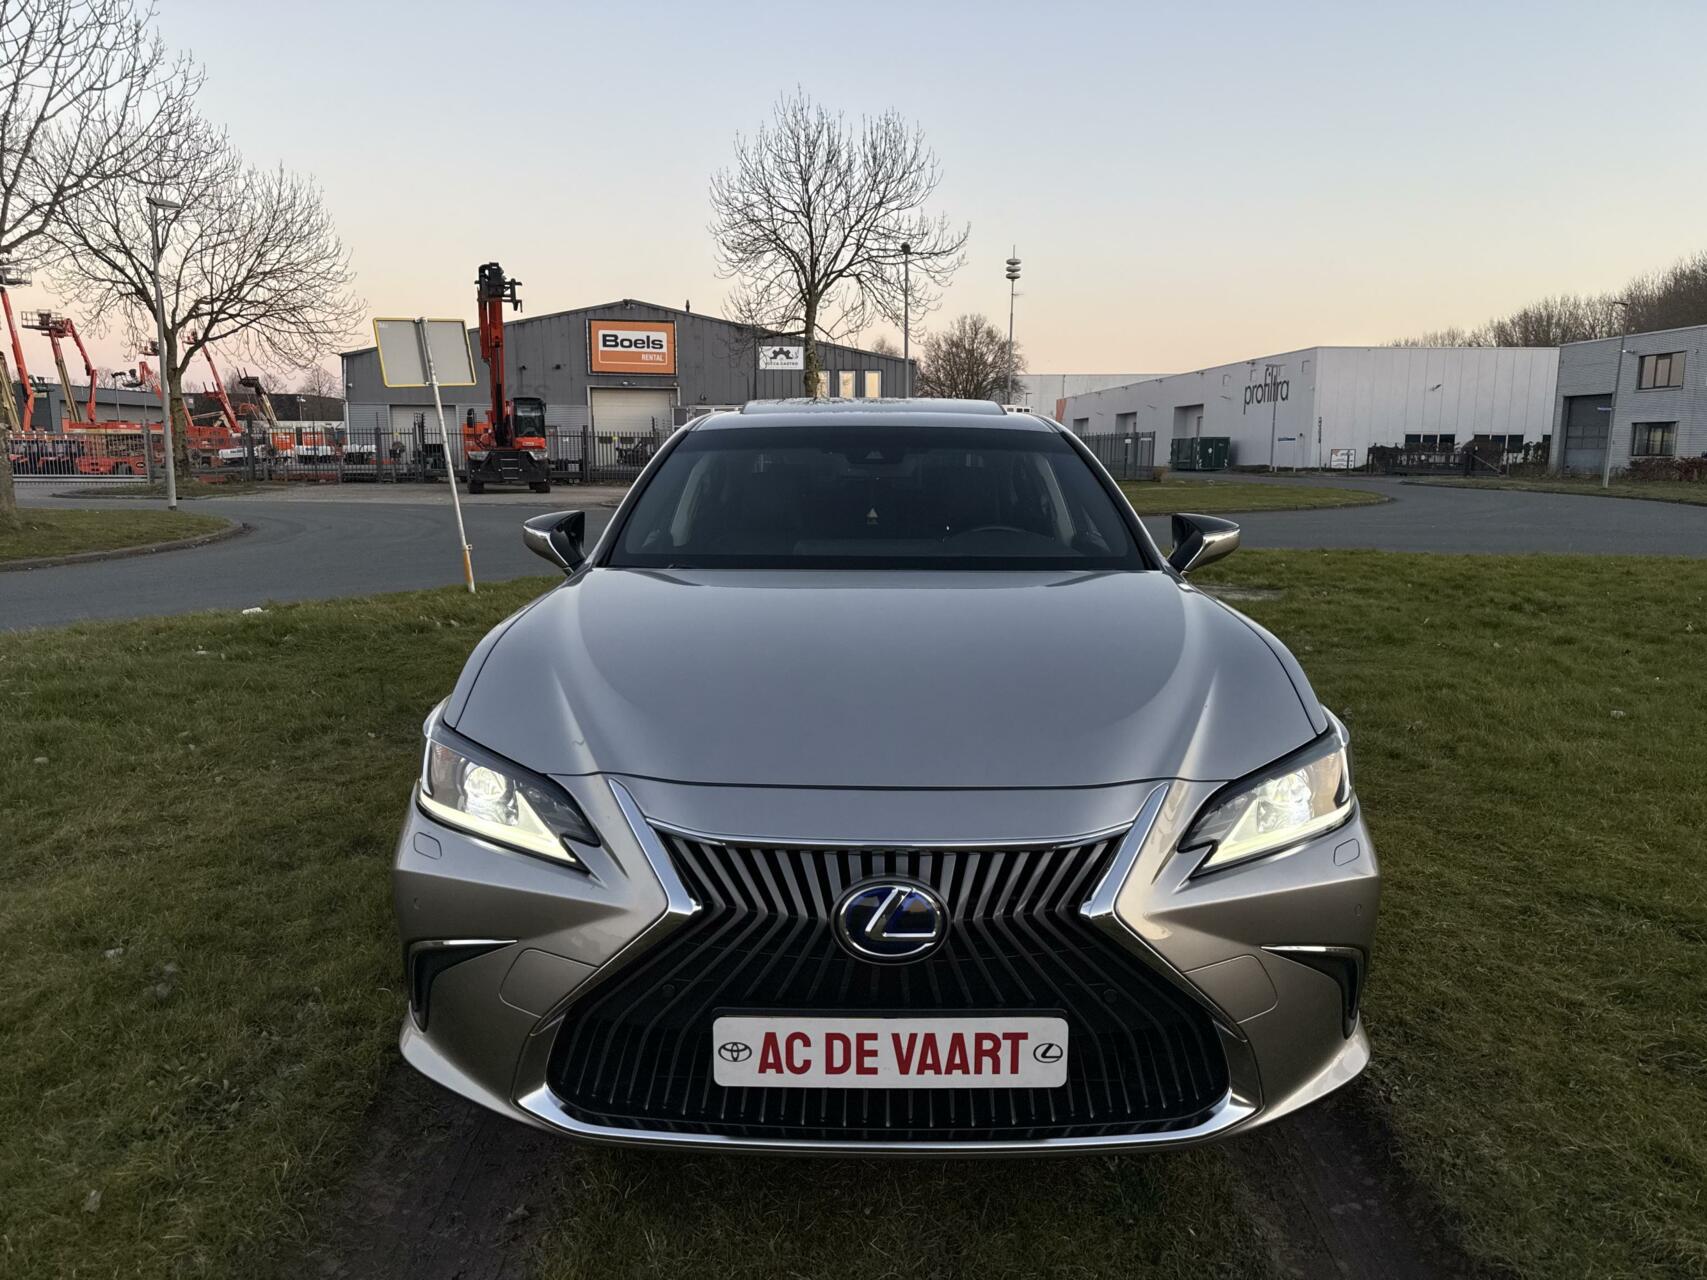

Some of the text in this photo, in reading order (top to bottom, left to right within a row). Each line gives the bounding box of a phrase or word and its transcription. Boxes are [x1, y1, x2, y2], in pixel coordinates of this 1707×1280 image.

[602, 333, 664, 350] Boels
[641, 353, 664, 362] RENTAL
[1243, 367, 1290, 416] profiltra
[758, 1031, 1029, 1076] AC DE VAART
